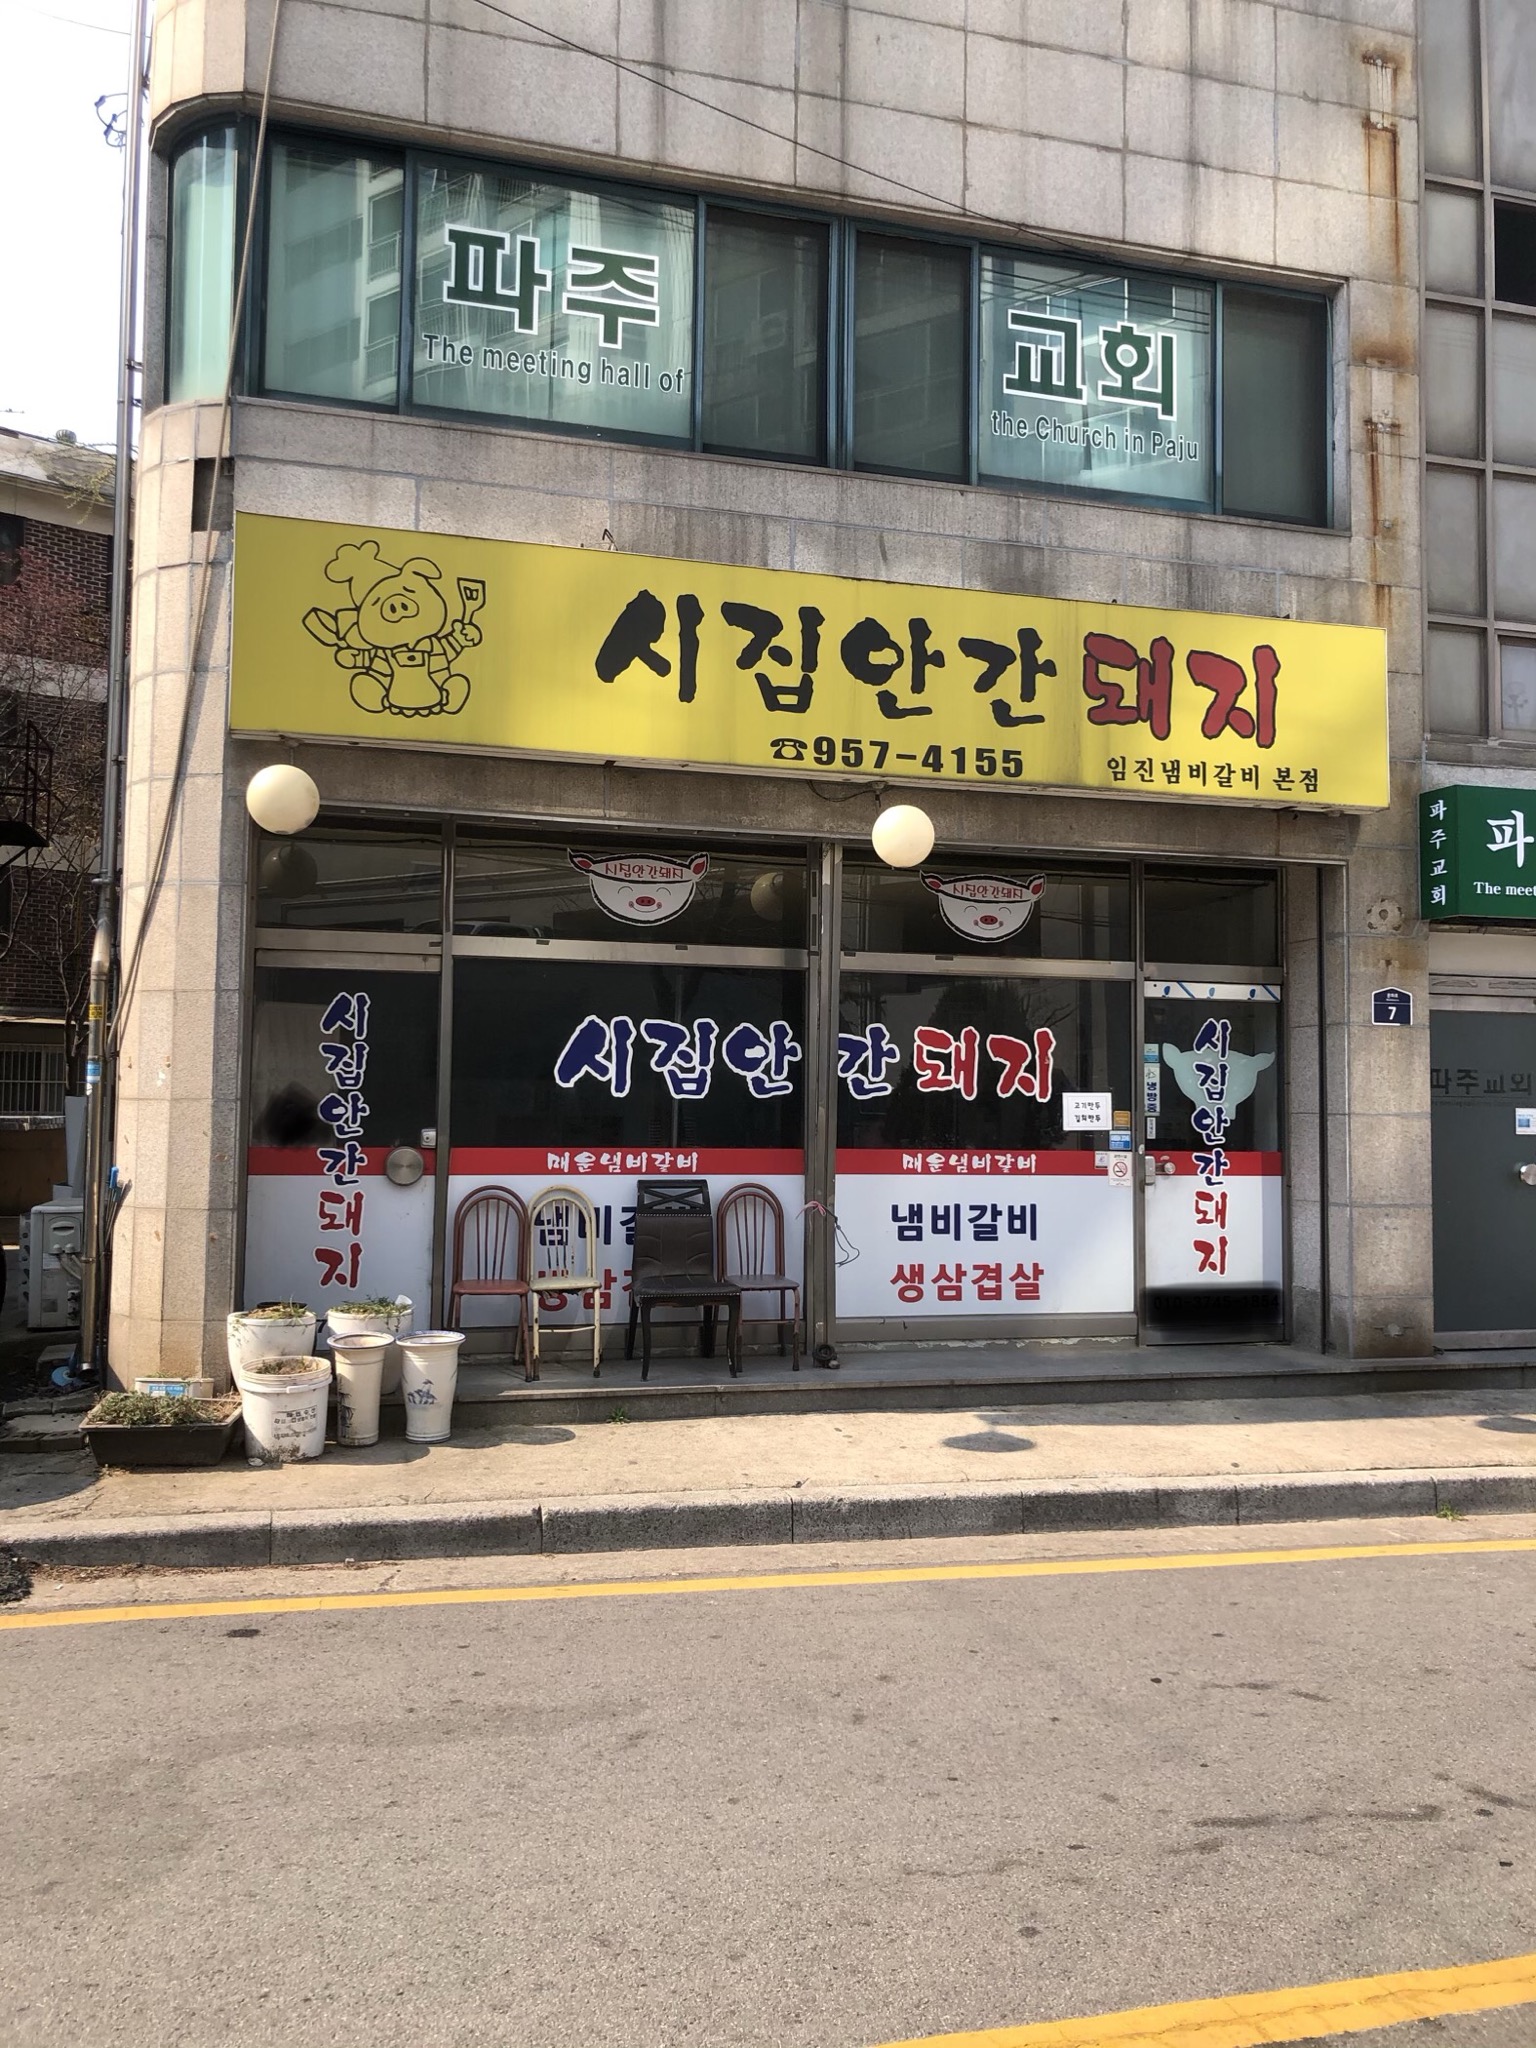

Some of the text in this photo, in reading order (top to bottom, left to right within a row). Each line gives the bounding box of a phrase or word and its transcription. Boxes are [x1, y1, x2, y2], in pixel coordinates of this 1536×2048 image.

[443, 223, 660, 350] 파주
[422, 333, 685, 394] The meeting hall of
[1003, 309, 1177, 422] 교회
[991, 410, 1199, 462] the Church in Paju
[812, 735, 1025, 778] 957-4155
[1273, 767, 1320, 793] 본점
[1429, 799, 1448, 906] 파주교회
[1486, 809, 1535, 869] 파
[1473, 881, 1502, 895] The
[1387, 1005, 1397, 1021] 7
[891, 1203, 1037, 1241] 냄비갈비
[890, 1262, 1045, 1303] 생삼겹살
